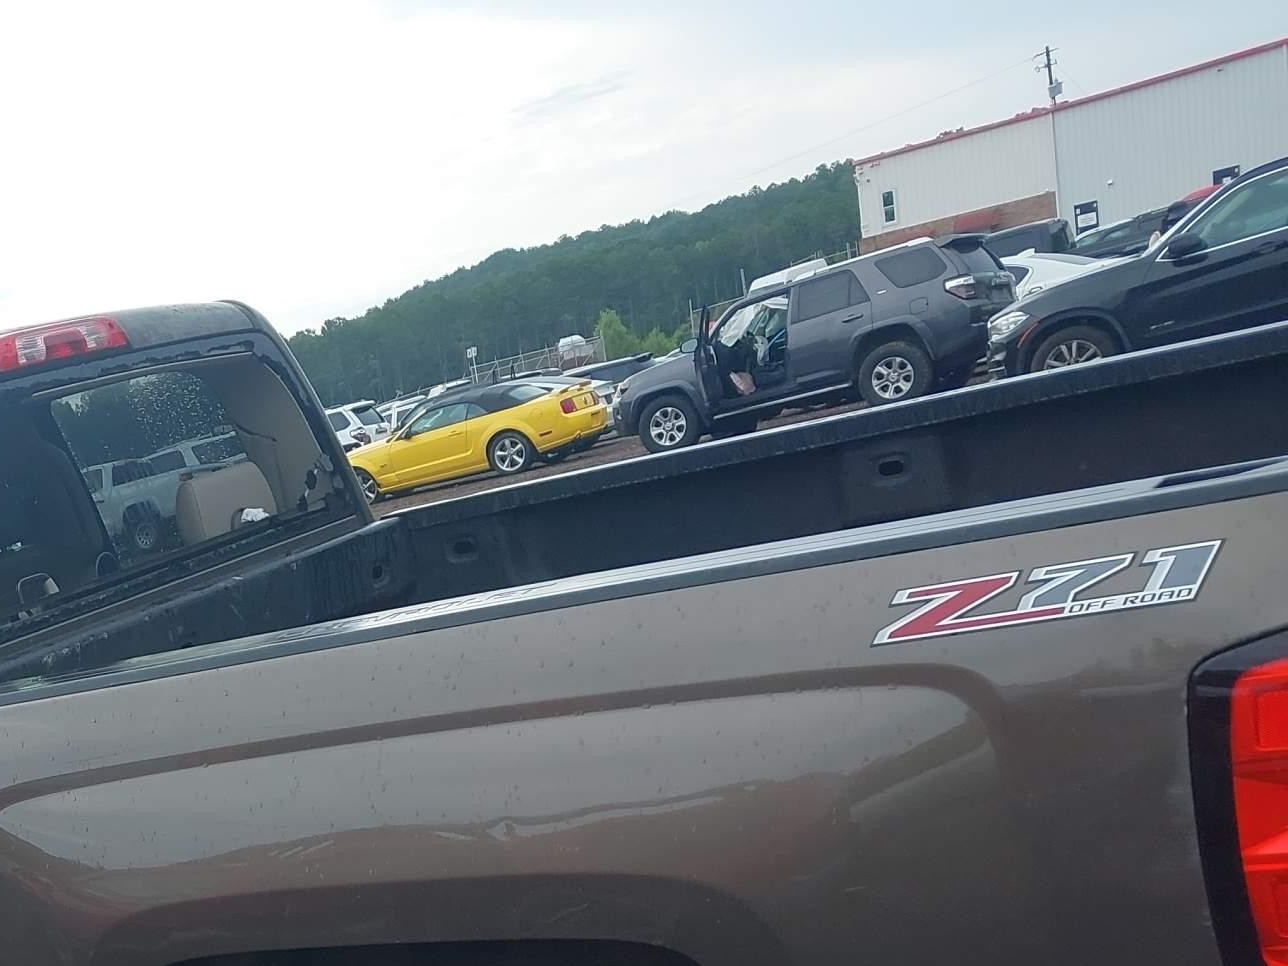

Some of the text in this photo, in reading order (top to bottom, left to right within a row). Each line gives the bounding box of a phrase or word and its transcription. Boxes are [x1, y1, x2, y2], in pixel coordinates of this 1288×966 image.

[871, 539, 1225, 647] Z71
[1067, 587, 1194, 615] OFF ROAD
